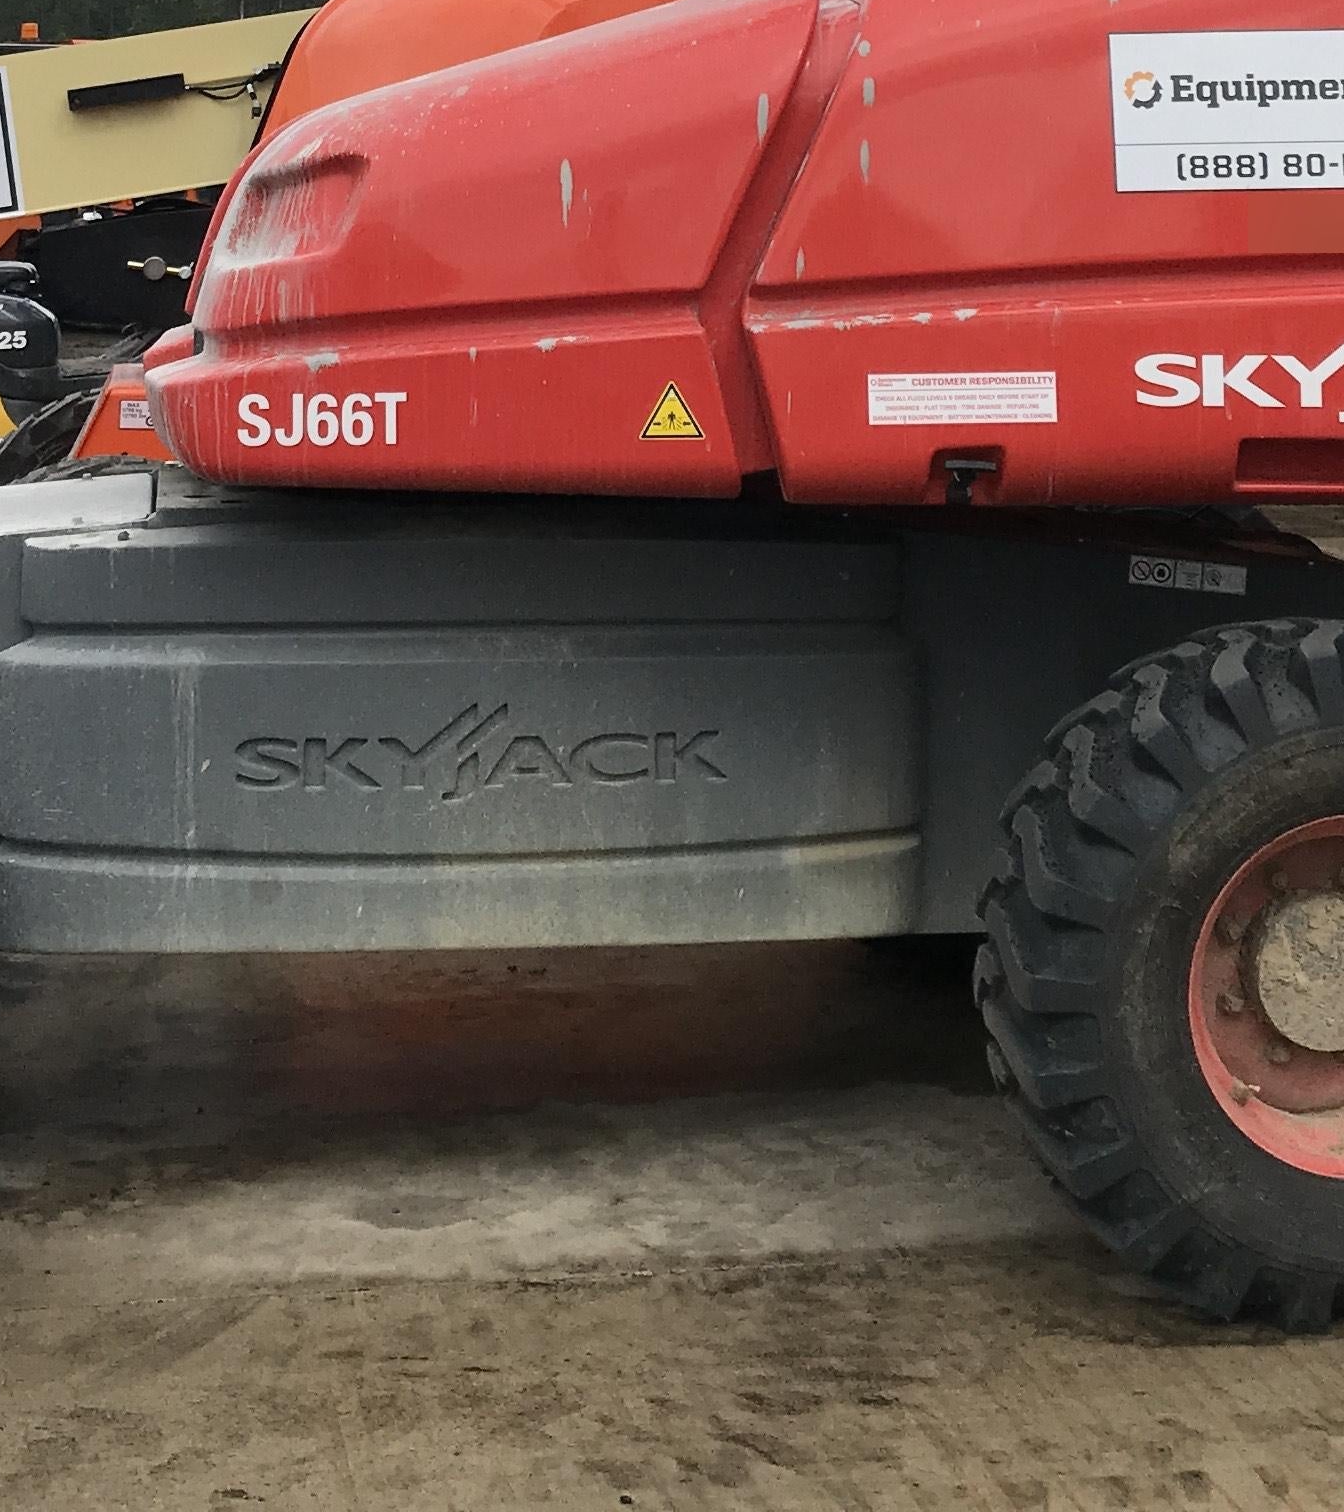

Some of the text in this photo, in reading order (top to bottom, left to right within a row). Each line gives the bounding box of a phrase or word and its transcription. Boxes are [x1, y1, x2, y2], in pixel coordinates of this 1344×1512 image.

[1176, 152, 1269, 181] (888)
[911, 377, 967, 387] CUSTOMER
[968, 376, 1053, 386] RESPONSIBILITY
[237, 392, 407, 447] SJ66T
[234, 703, 728, 802] SKYJACK
